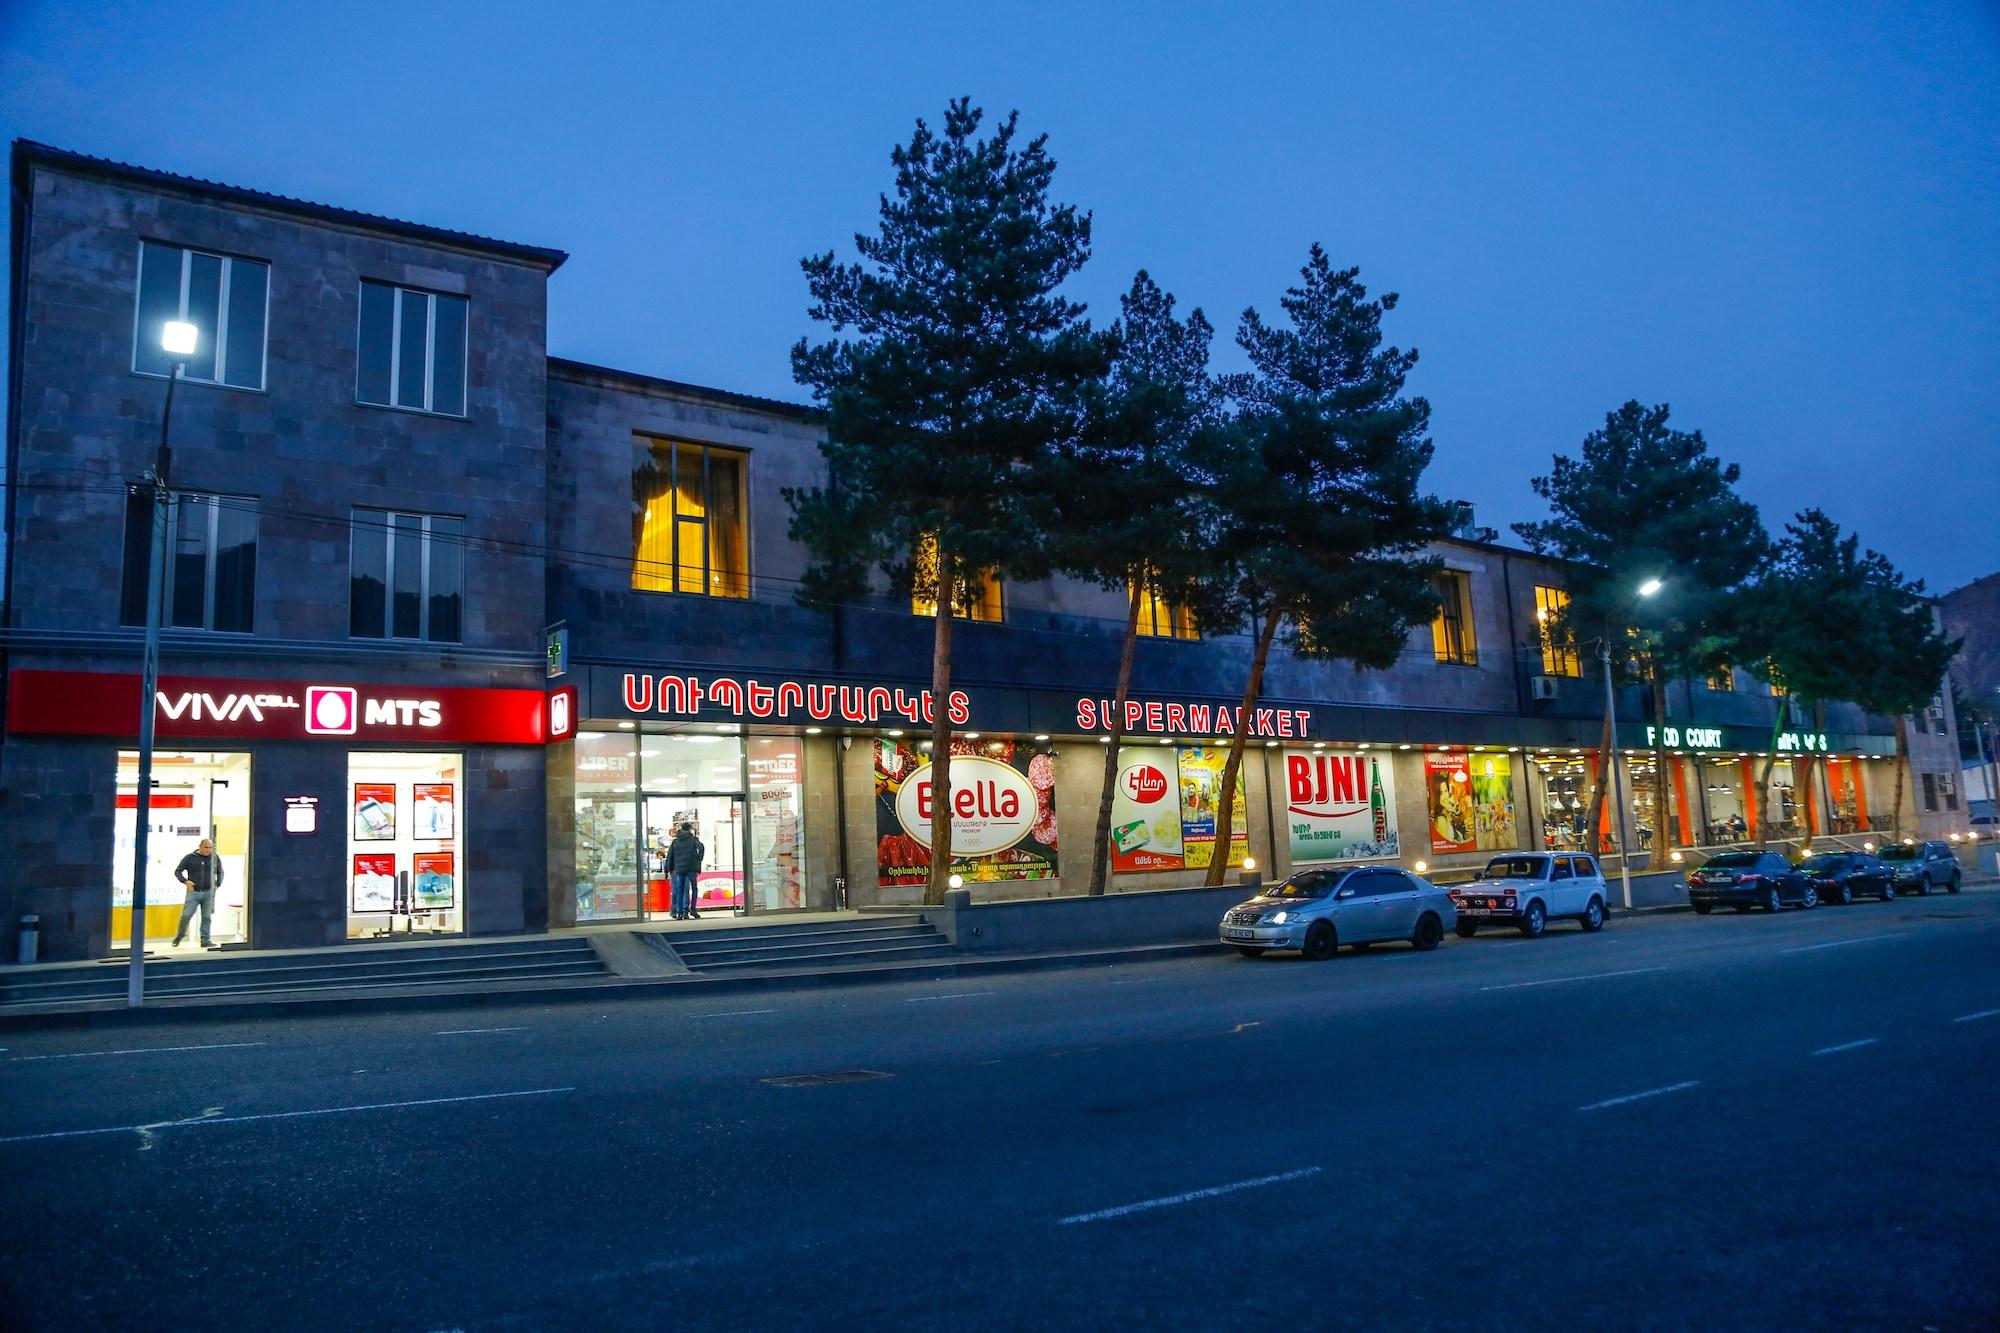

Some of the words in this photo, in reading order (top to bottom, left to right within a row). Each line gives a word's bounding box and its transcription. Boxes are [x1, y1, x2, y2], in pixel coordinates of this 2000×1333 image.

[364, 698, 442, 727] MTS
[1646, 726, 1680, 747] FOD
[1685, 727, 1722, 749] COURT
[1287, 755, 1368, 806] BJNI
